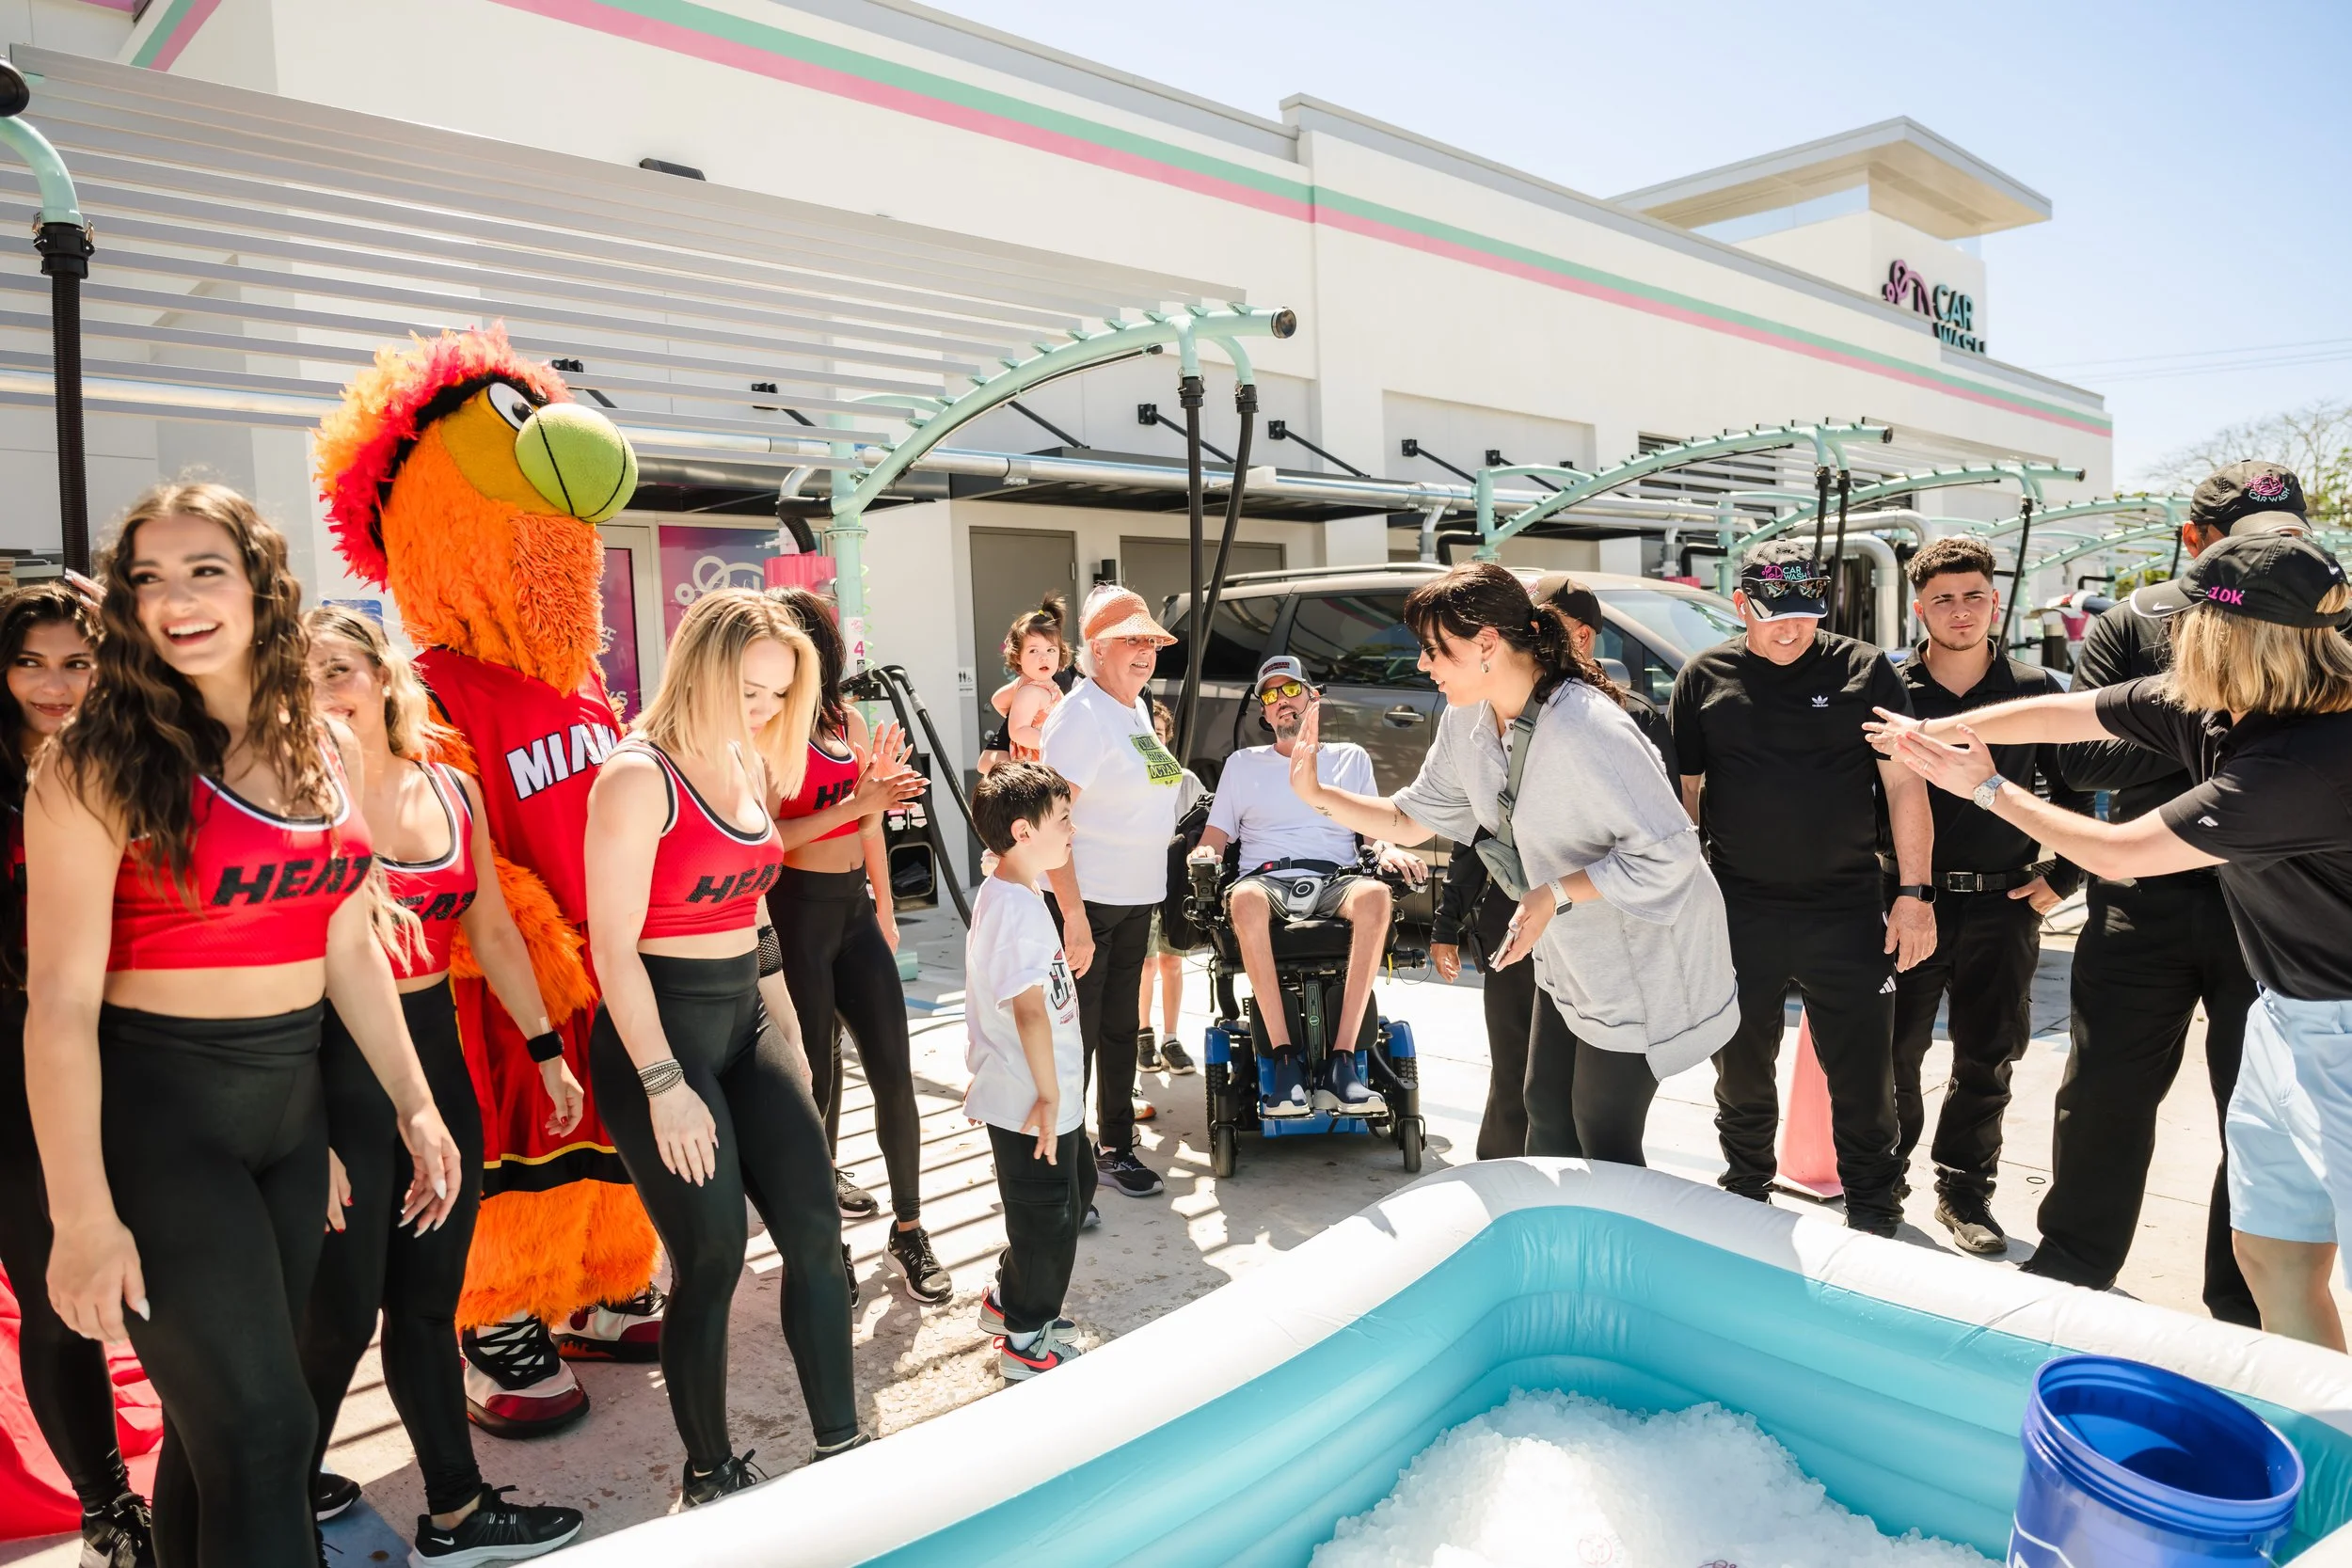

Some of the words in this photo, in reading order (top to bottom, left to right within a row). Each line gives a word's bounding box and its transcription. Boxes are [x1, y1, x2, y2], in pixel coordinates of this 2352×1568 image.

[1932, 284, 1974, 331] CAR
[2249, 491, 2268, 502] CAR
[2268, 487, 2291, 502] WASH
[1784, 572, 1807, 580] WASH
[853, 641, 865, 657] 4
